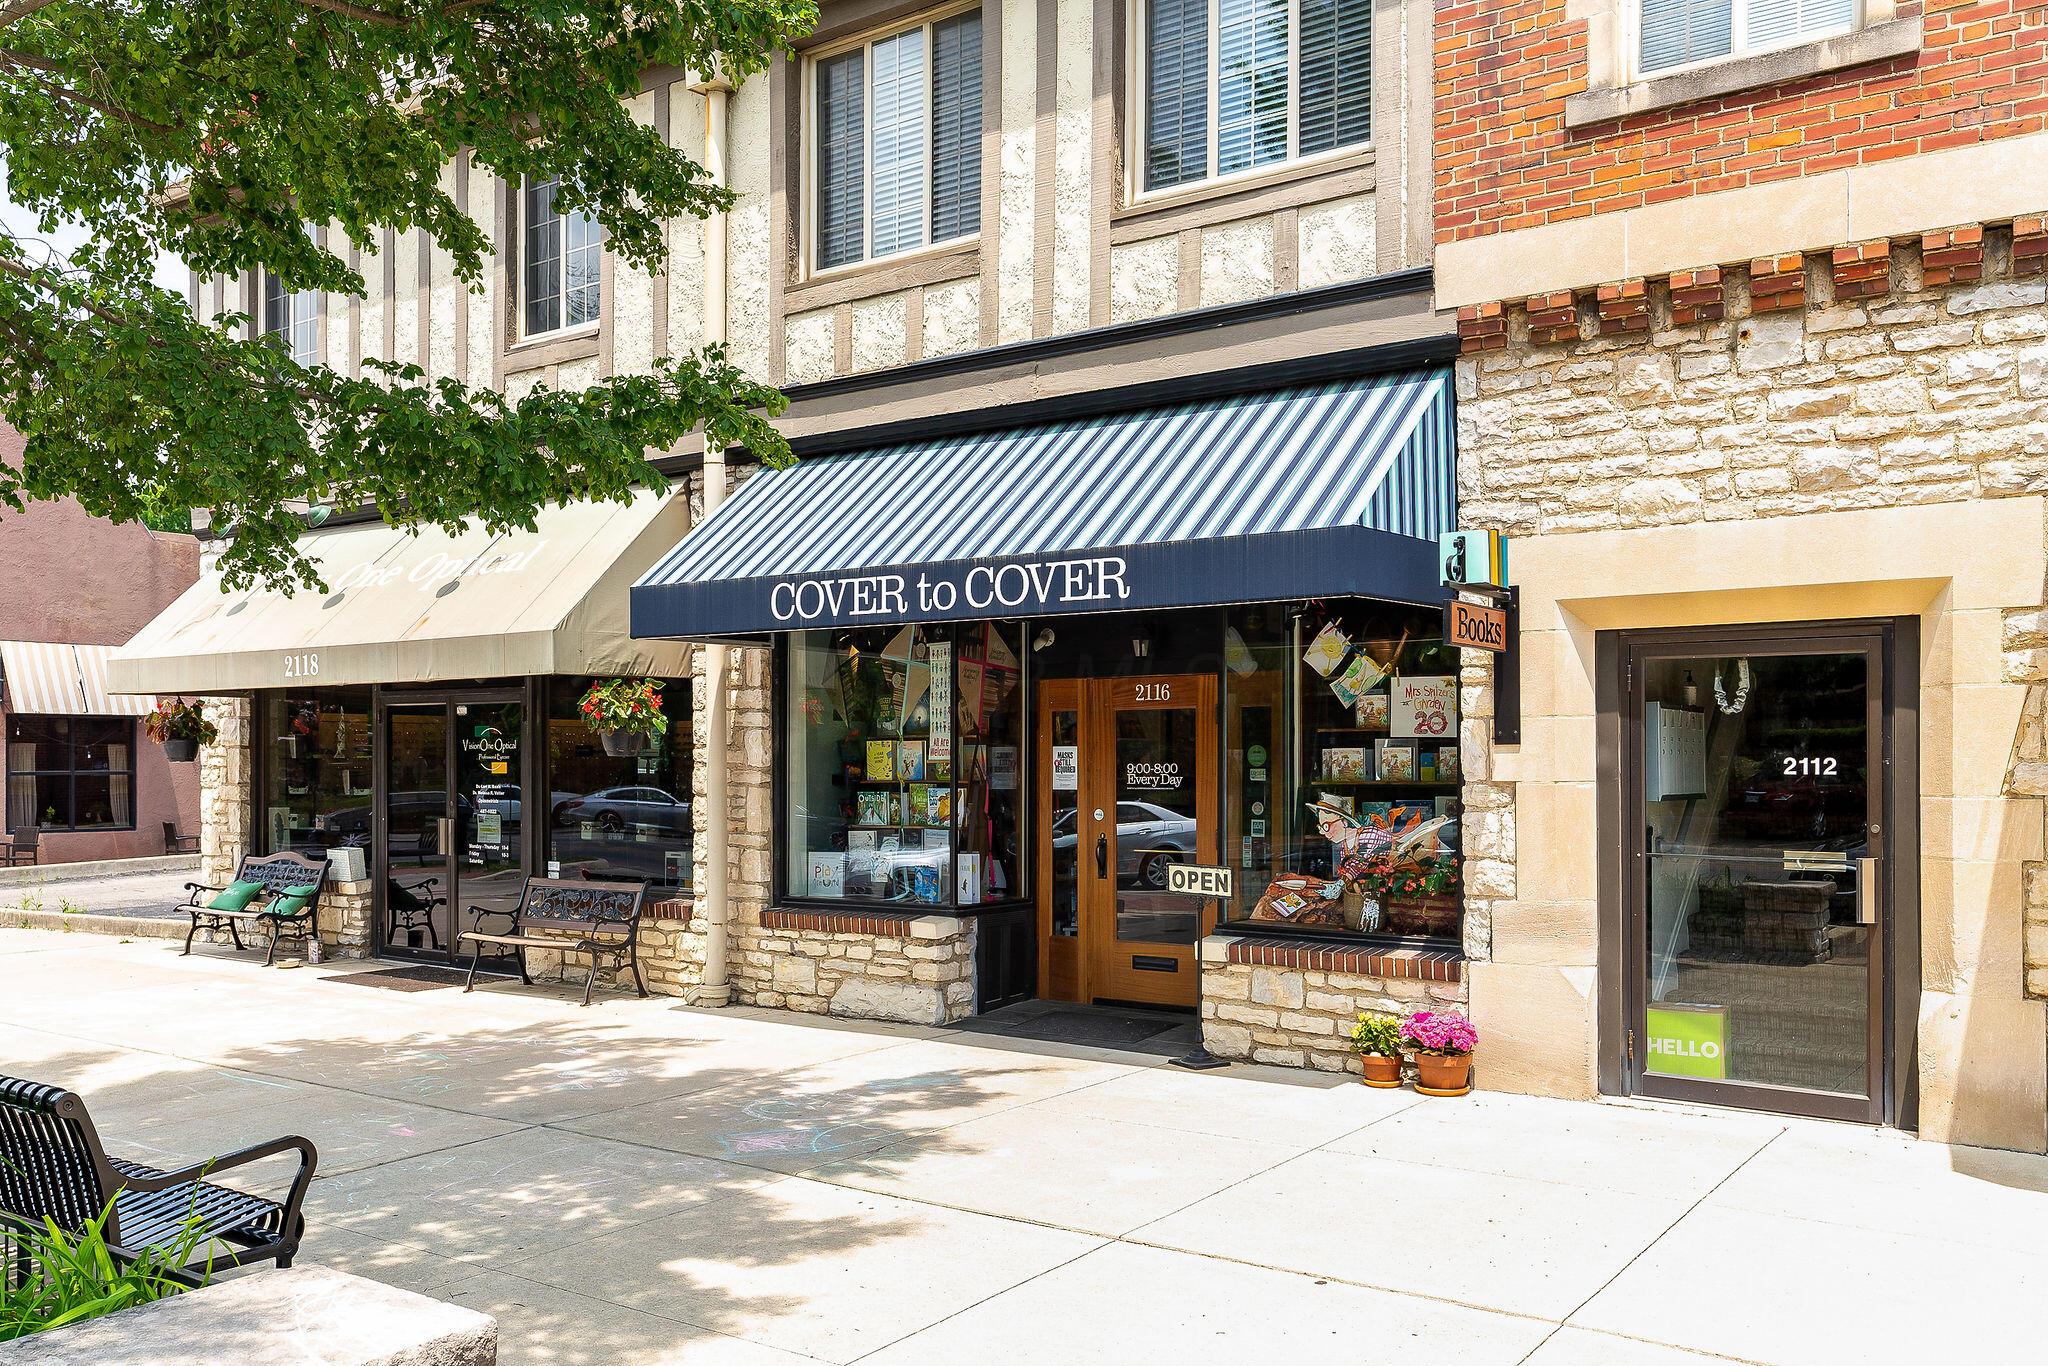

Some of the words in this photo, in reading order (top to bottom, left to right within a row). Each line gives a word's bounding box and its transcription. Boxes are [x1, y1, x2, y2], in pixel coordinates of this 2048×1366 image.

[335, 562, 403, 590] One
[408, 539, 549, 591] Optical
[771, 575, 909, 621] COVER
[917, 572, 957, 612] to
[964, 556, 1131, 609] COVER
[1456, 606, 1502, 645] Books
[284, 653, 319, 678] 2118
[1135, 683, 1170, 701] 2116
[1413, 711, 1448, 735] 20
[494, 738, 516, 753] Optical
[940, 738, 950, 747] Are
[930, 747, 950, 757] Welcom
[1057, 751, 1073, 759] MASKS
[1127, 763, 1178, 774] 9:00-8:00
[1782, 757, 1837, 775] 2112
[1127, 774, 1160, 787] Every
[1161, 774, 1183, 788] Day
[1172, 869, 1229, 893] OPEN
[1647, 1037, 1720, 1059] HELLO
